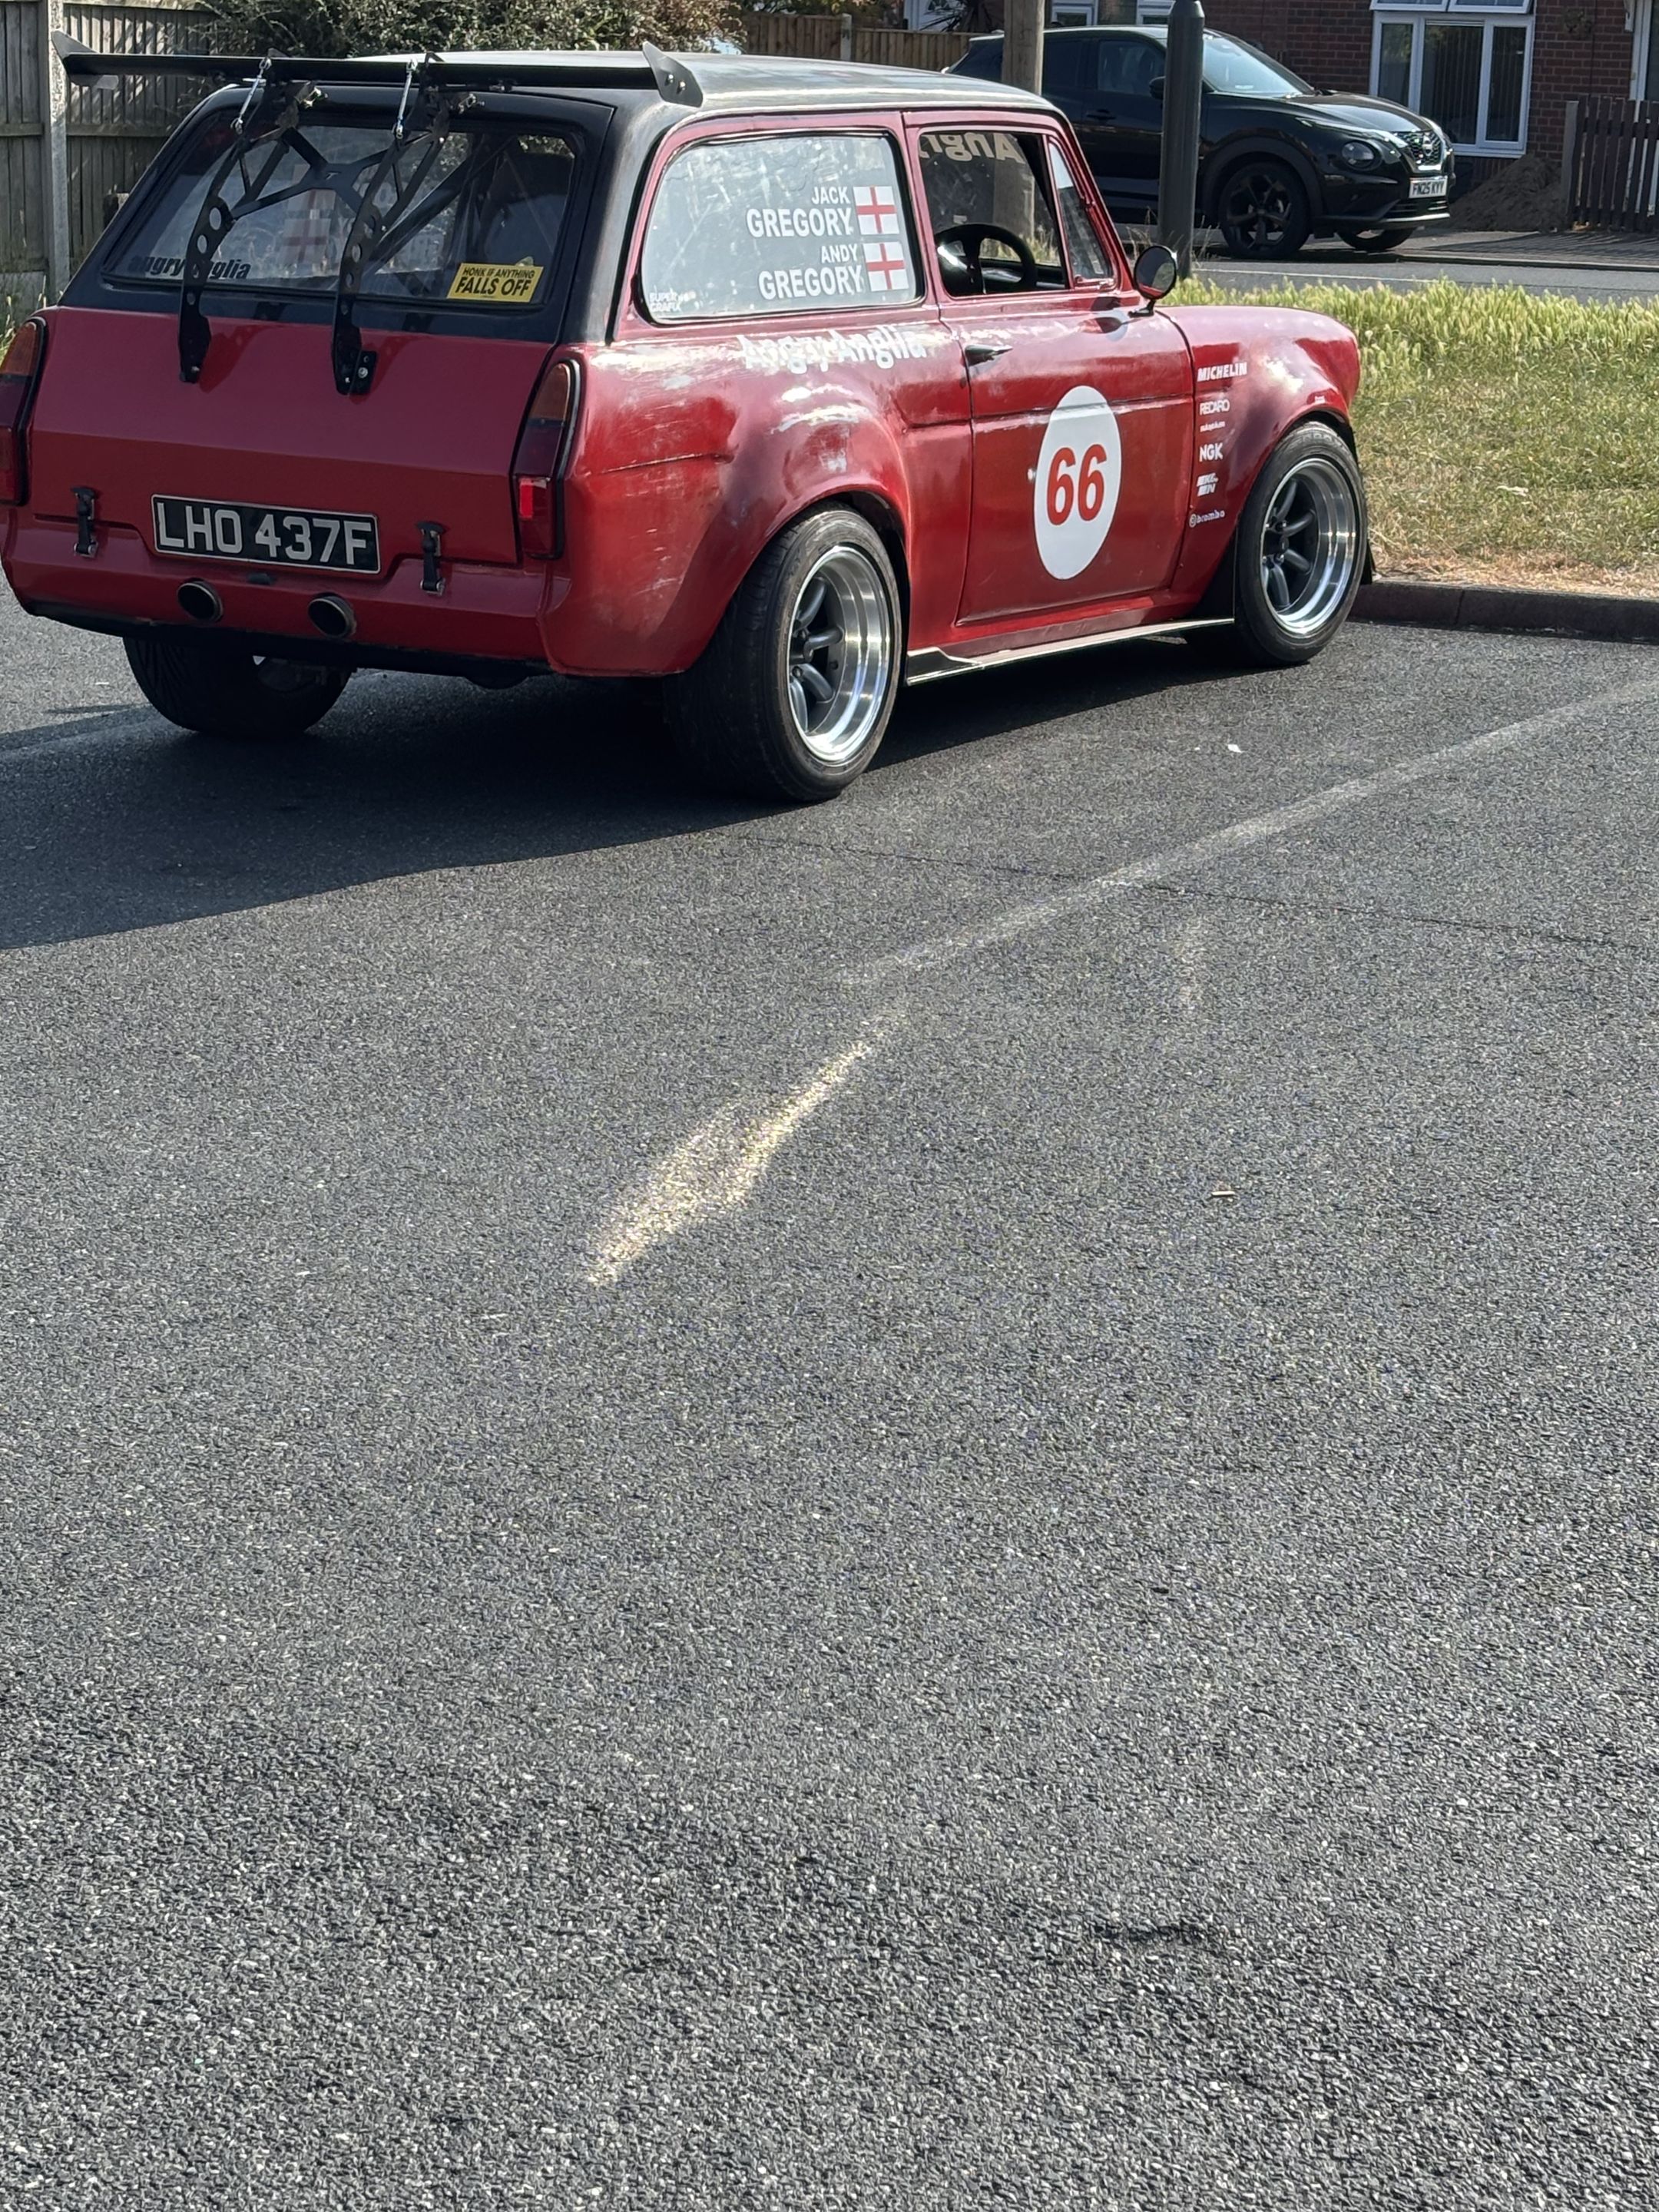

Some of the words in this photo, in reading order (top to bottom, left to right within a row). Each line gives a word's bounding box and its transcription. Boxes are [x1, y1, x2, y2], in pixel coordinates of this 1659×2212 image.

[811, 187, 851, 204] JACK
[747, 207, 852, 237] GREGORY
[821, 243, 858, 263] ANDY
[462, 267, 485, 276] HONK
[486, 269, 495, 277] IF
[495, 269, 535, 279] ANYTHING
[759, 265, 863, 300] GREGORY
[455, 276, 500, 295] FALLS
[501, 278, 531, 296] OFF
[1197, 362, 1247, 382] MICHELIN
[1199, 442, 1224, 462] NGK
[1046, 443, 1108, 526] 66
[157, 502, 243, 554] LHO
[255, 513, 372, 565] 437F
